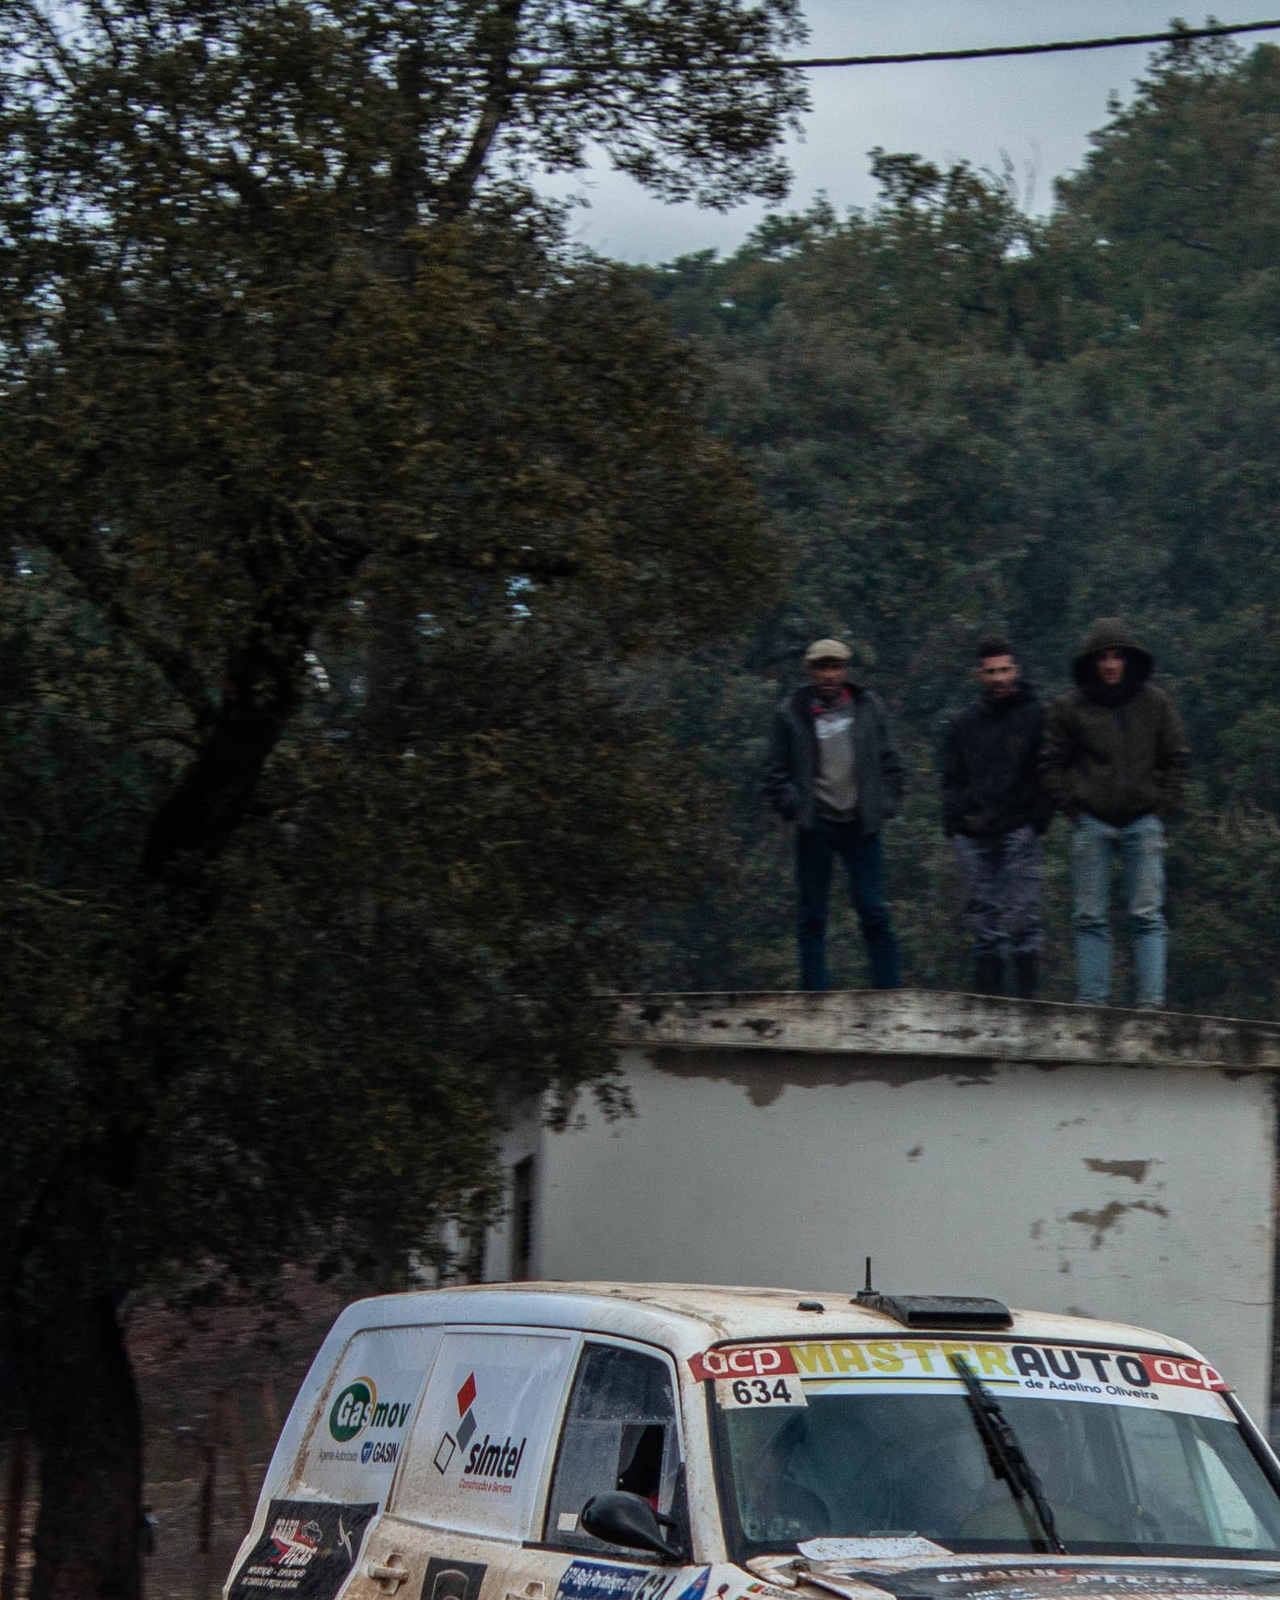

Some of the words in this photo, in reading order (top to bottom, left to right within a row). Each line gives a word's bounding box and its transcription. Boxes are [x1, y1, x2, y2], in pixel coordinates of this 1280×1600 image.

[702, 1348, 782, 1374] acp
[1153, 1360, 1225, 1389] acp
[732, 1379, 792, 1404] 634
[1025, 1378, 1044, 1389] de
[1049, 1381, 1102, 1394] Adelino
[1106, 1385, 1159, 1400] Oliveira
[373, 1442, 400, 1463] GASIN
